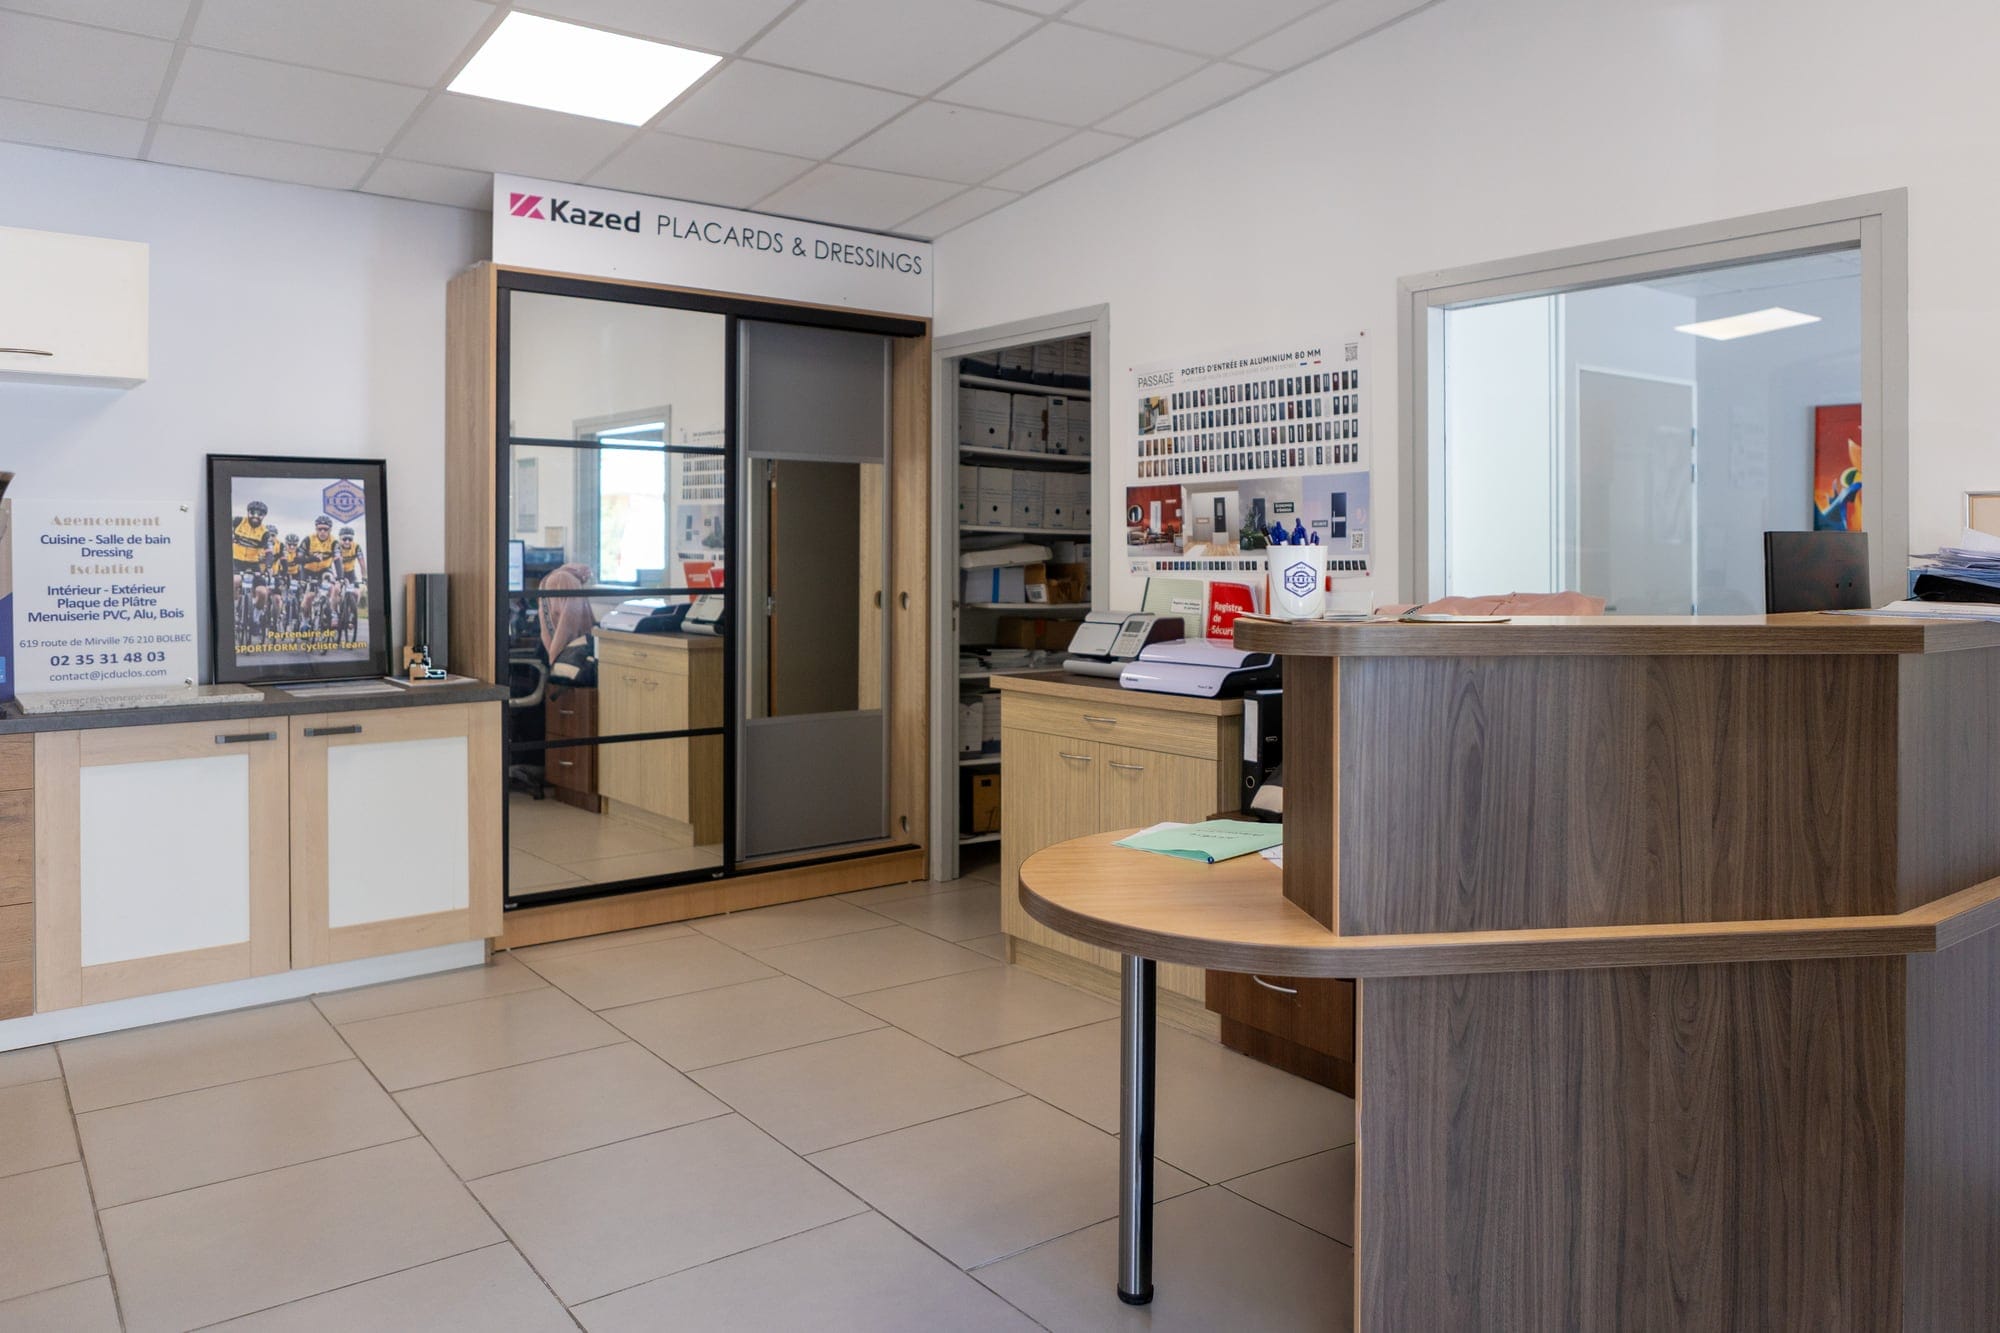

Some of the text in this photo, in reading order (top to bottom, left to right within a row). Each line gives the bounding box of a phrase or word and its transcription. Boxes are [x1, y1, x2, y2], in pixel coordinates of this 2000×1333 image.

[551, 198, 922, 275] Kazed PLACARDS & DRESSINGS
[1181, 366, 1205, 376] PORTES
[1207, 360, 1238, 372] D'ENTRÉE
[1240, 359, 1248, 367] EN
[1249, 353, 1293, 366] ALUMINIUM
[1295, 350, 1305, 359] 80
[1307, 348, 1321, 358] MM
[1137, 372, 1175, 388] PASSAGE
[51, 515, 160, 527] Agencement
[40, 534, 86, 545] Cuisine
[95, 534, 124, 545] Salle
[126, 534, 143, 545] de
[145, 534, 171, 545] bain
[81, 547, 134, 559] Dressing
[69, 564, 145, 575] Isolation
[47, 585, 101, 596] Intérieur
[111, 584, 166, 595] Extérieur
[57, 596, 157, 610] Plaque de Plâtre
[1214, 601, 1243, 613] Registre
[27, 608, 184, 623] Menuiserie PVC, Alu, Bois
[1213, 614, 1222, 623] de
[268, 629, 336, 639] Partenaire de
[19, 634, 192, 648] 619 route de Mirville 76 210 BOLBEC
[234, 640, 367, 654] SPORTFORM Cycliste Team
[50, 651, 166, 667] 02 35 31 48 03
[49, 669, 167, 682] contact@jcduclos.com
